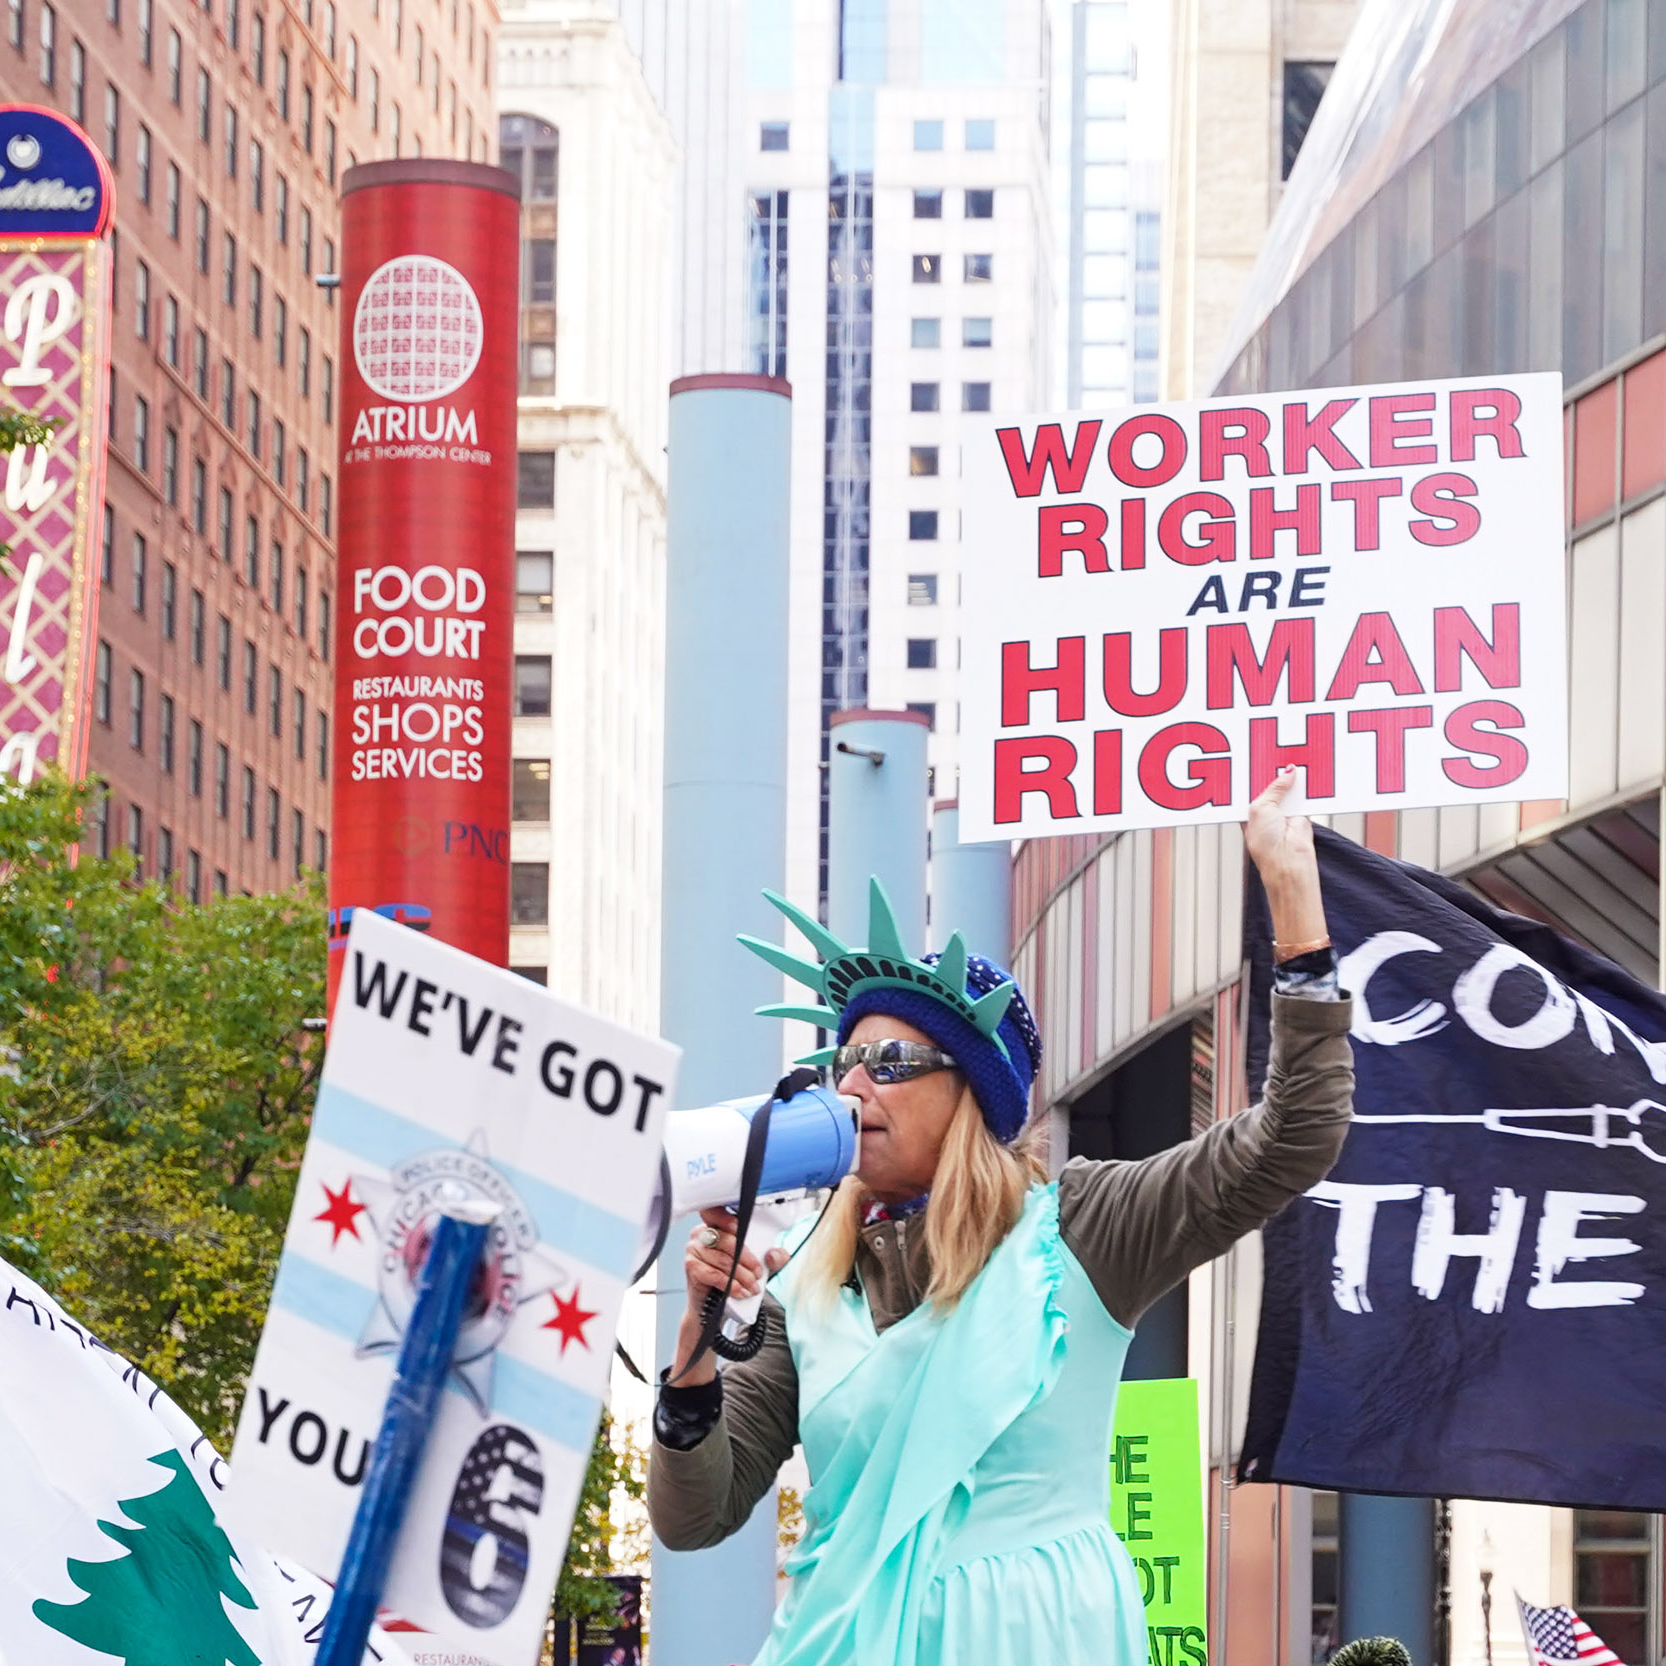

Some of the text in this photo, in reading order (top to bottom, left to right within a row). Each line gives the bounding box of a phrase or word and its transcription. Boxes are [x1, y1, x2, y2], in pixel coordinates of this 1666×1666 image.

[351, 405, 478, 445] ATRIUM
[995, 387, 1528, 498] WORKER
[355, 447, 372, 462] THE
[375, 445, 446, 461] THOMPSON
[450, 447, 492, 465] CENTER
[1037, 471, 1481, 577] RIGHTS
[354, 565, 486, 614] FOOD
[1186, 566, 1331, 616] ARE
[353, 616, 486, 659] COURT
[352, 675, 484, 701] RESTAURANTS
[1000, 601, 1521, 727] HUMAN
[352, 702, 484, 745] SHOPS
[351, 748, 484, 782] SERVICES
[993, 700, 1529, 825] RIGHTS
[443, 821, 509, 866] PNC
[352, 951, 664, 1135] WE'VE GOT
[686, 1154, 717, 1177] PYLE
[1303, 1182, 1648, 1315] THE
[257, 1387, 545, 1629] YOU 6
